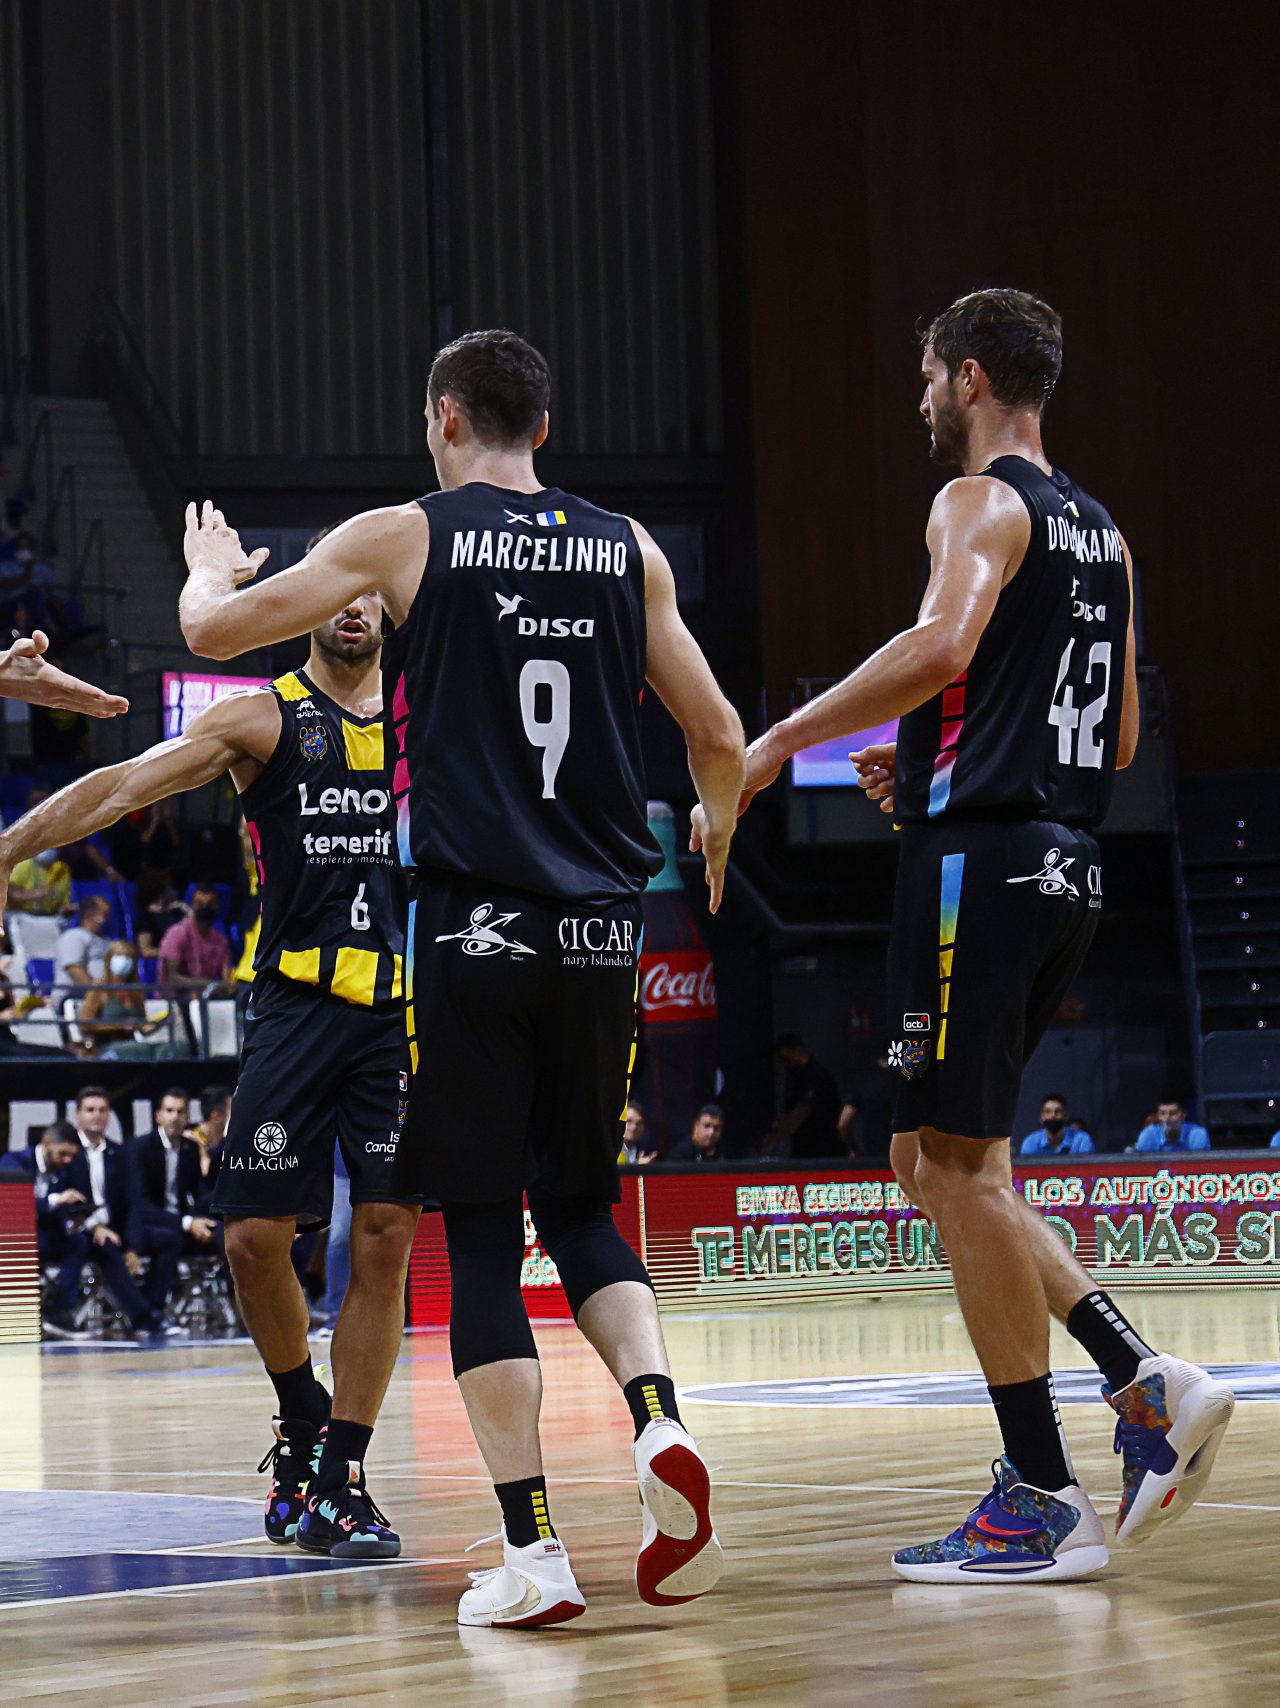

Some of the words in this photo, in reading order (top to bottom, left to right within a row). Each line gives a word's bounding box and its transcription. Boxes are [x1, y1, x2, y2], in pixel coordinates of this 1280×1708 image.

[450, 530, 627, 577] MARCELINHO
[1047, 637, 1112, 769] 42
[519, 659, 571, 799] 9
[298, 782, 392, 816] Leno
[303, 828, 392, 856] tenerif
[350, 883, 370, 931] 6
[558, 917, 634, 951] CICAR
[563, 956, 588, 968] nary
[230, 1156, 245, 1170] LA
[365, 1141, 397, 1153] Cana
[736, 1185, 801, 1215] DIVINA
[804, 1182, 884, 1214] SEGUROS
[1024, 1177, 1085, 1206] LOS
[691, 1227, 736, 1281] TE
[742, 1220, 891, 1280] MERECES
[895, 1217, 946, 1272] UN
[1094, 1203, 1220, 1268] MÁS
